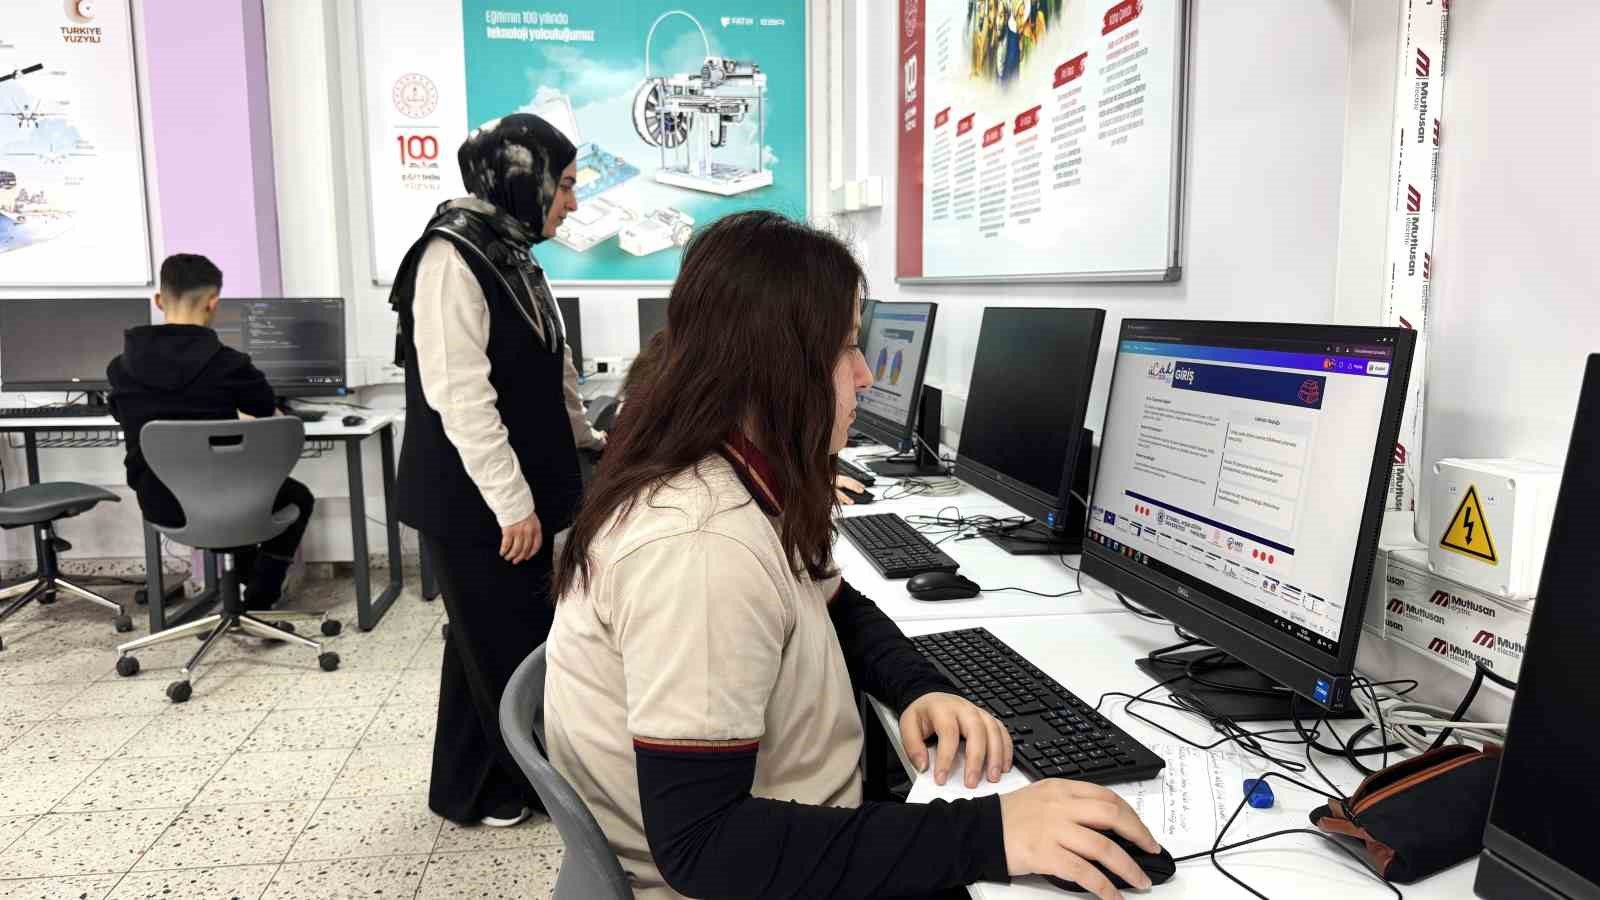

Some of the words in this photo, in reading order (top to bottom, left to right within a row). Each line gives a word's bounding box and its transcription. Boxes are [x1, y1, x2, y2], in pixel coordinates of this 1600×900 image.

[1417, 81, 1429, 144] Mutlusan
[397, 135, 439, 165] 100
[1408, 216, 1420, 277] Mutlusan
[1406, 603, 1445, 625] Mutlusan
[1451, 595, 1496, 618] Mutlusan
[1450, 643, 1493, 669] Mutlusan
